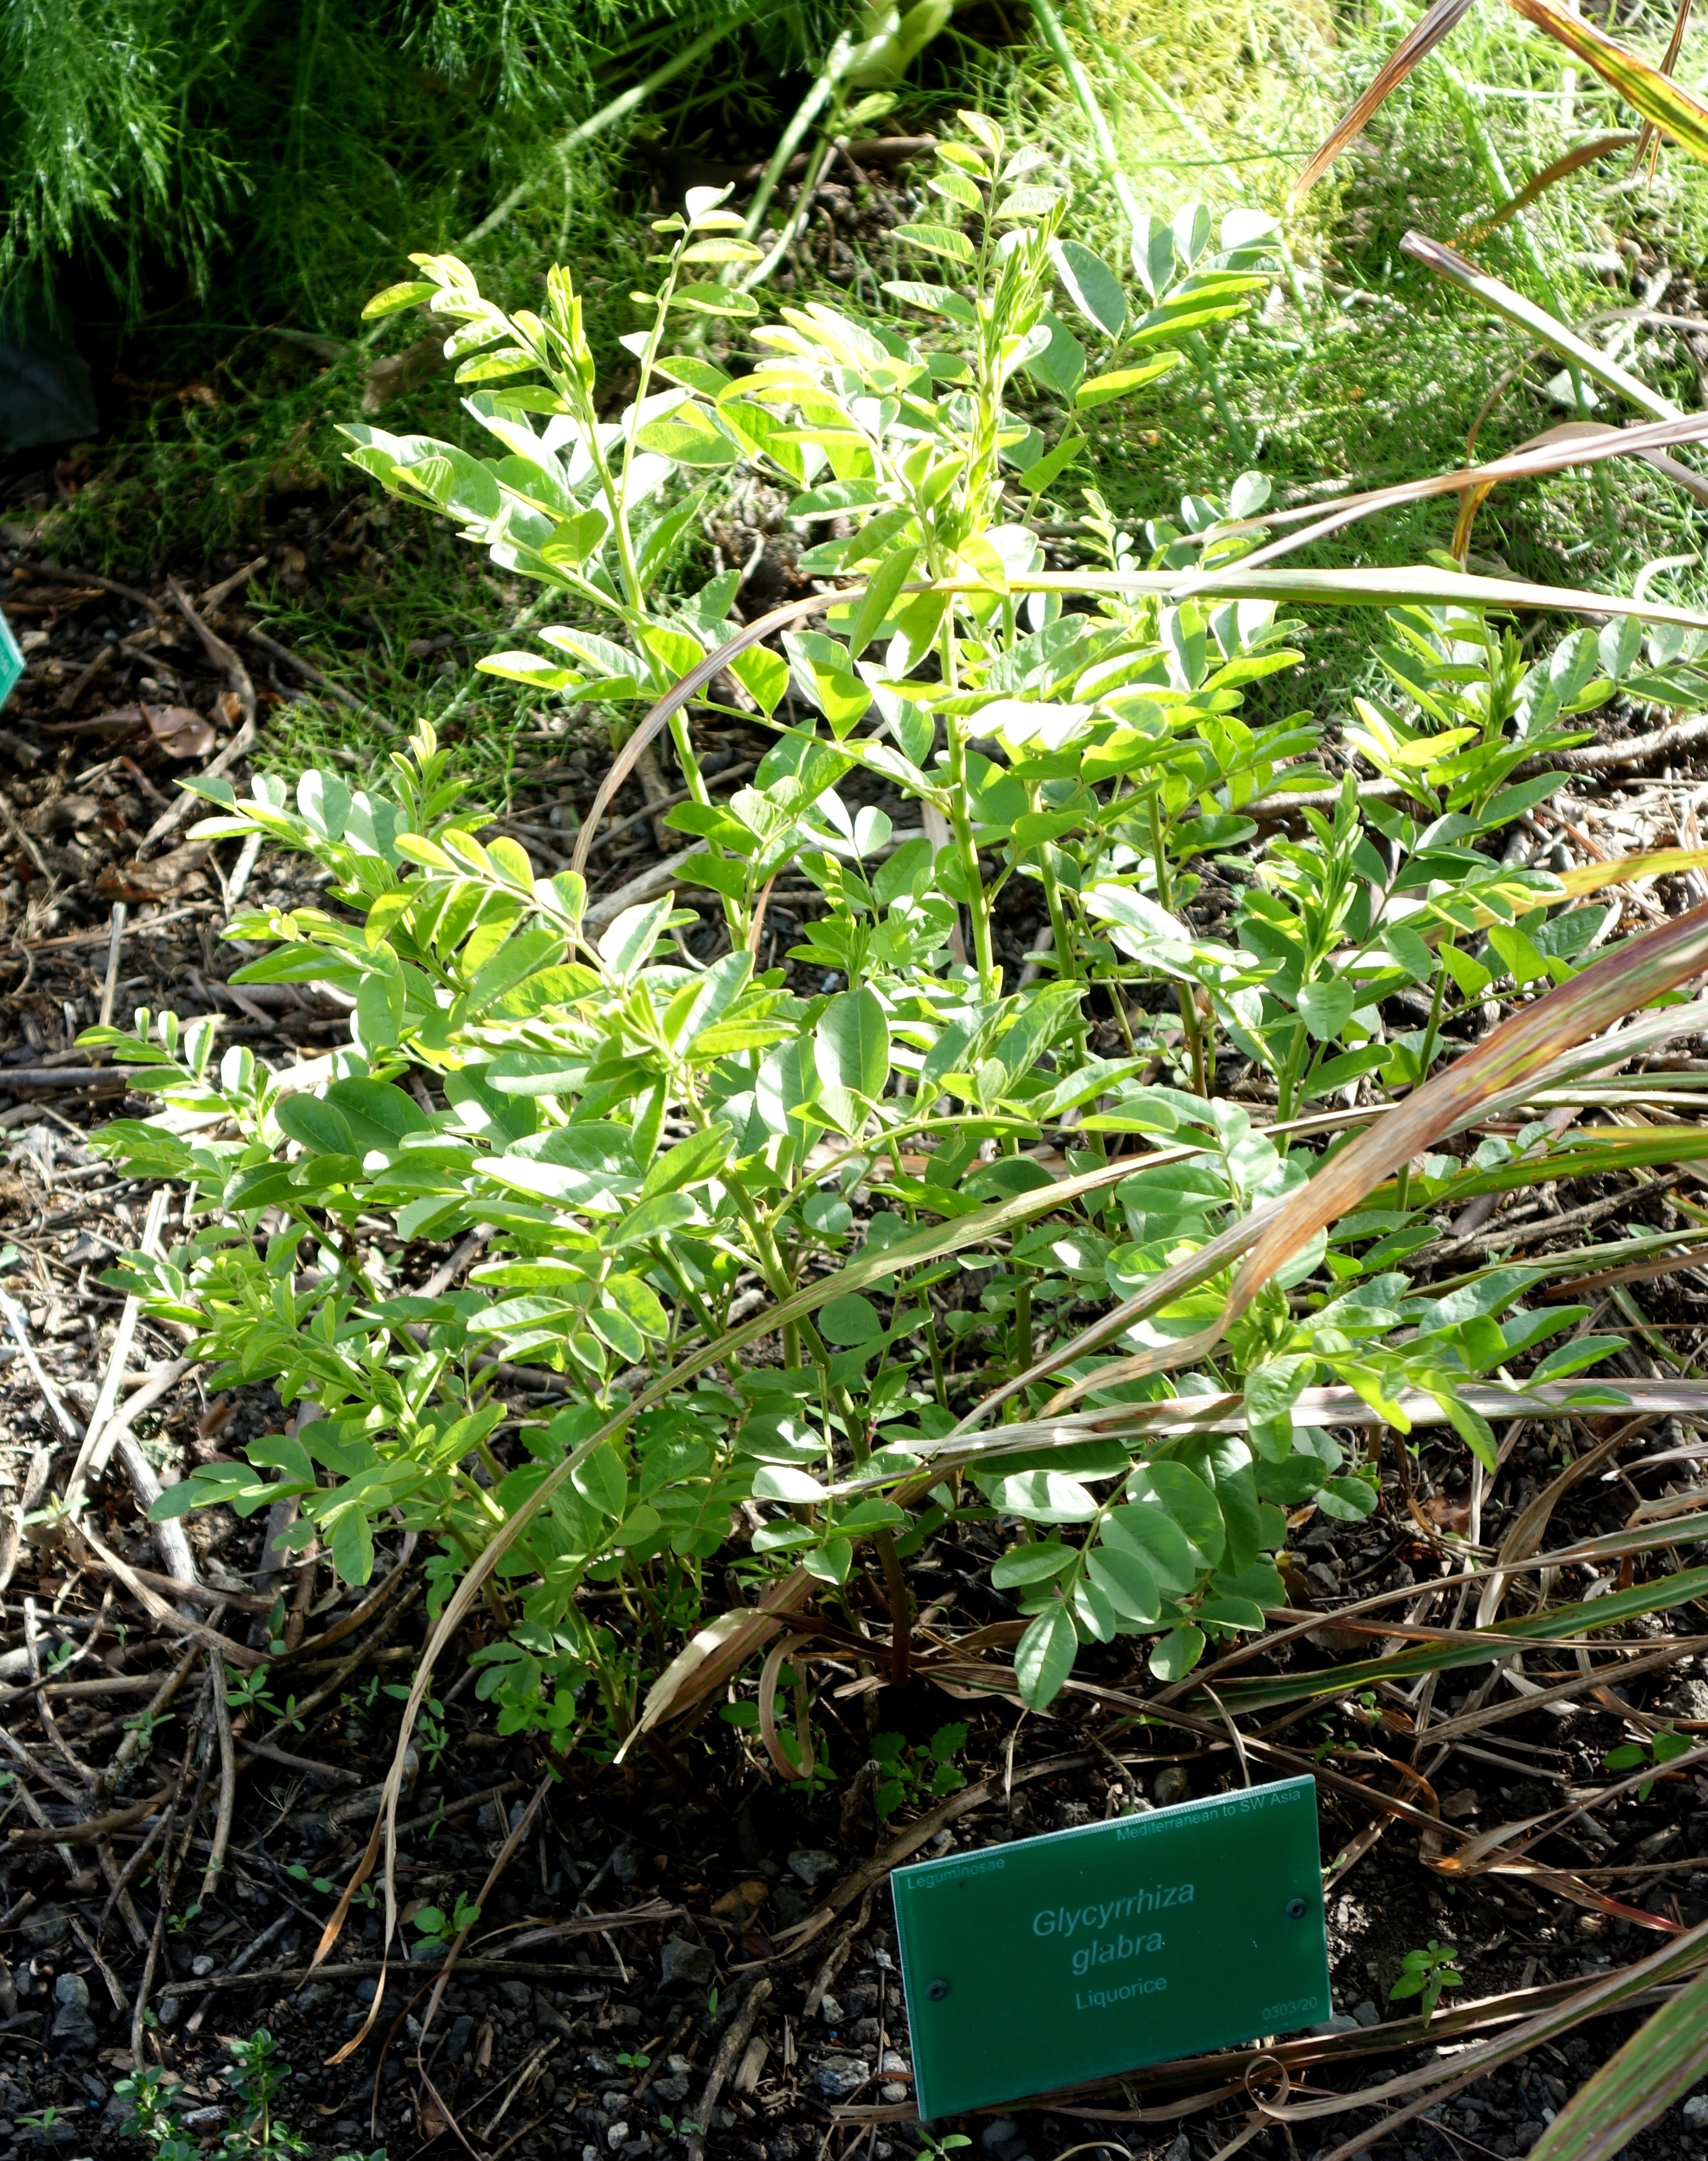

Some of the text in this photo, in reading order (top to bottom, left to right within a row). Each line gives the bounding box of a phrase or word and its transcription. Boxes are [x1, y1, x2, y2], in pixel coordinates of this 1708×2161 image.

[1116, 1789, 1301, 1841] Mediterranean to SW Asia
[907, 1858, 1005, 1890] Leguminosae
[1032, 1883, 1195, 1937] Glycyrrhiza
[1072, 1932, 1163, 1976] glabra
[1075, 1976, 1168, 2010] Liquorice
[1262, 1997, 1318, 2020] 0303/20
